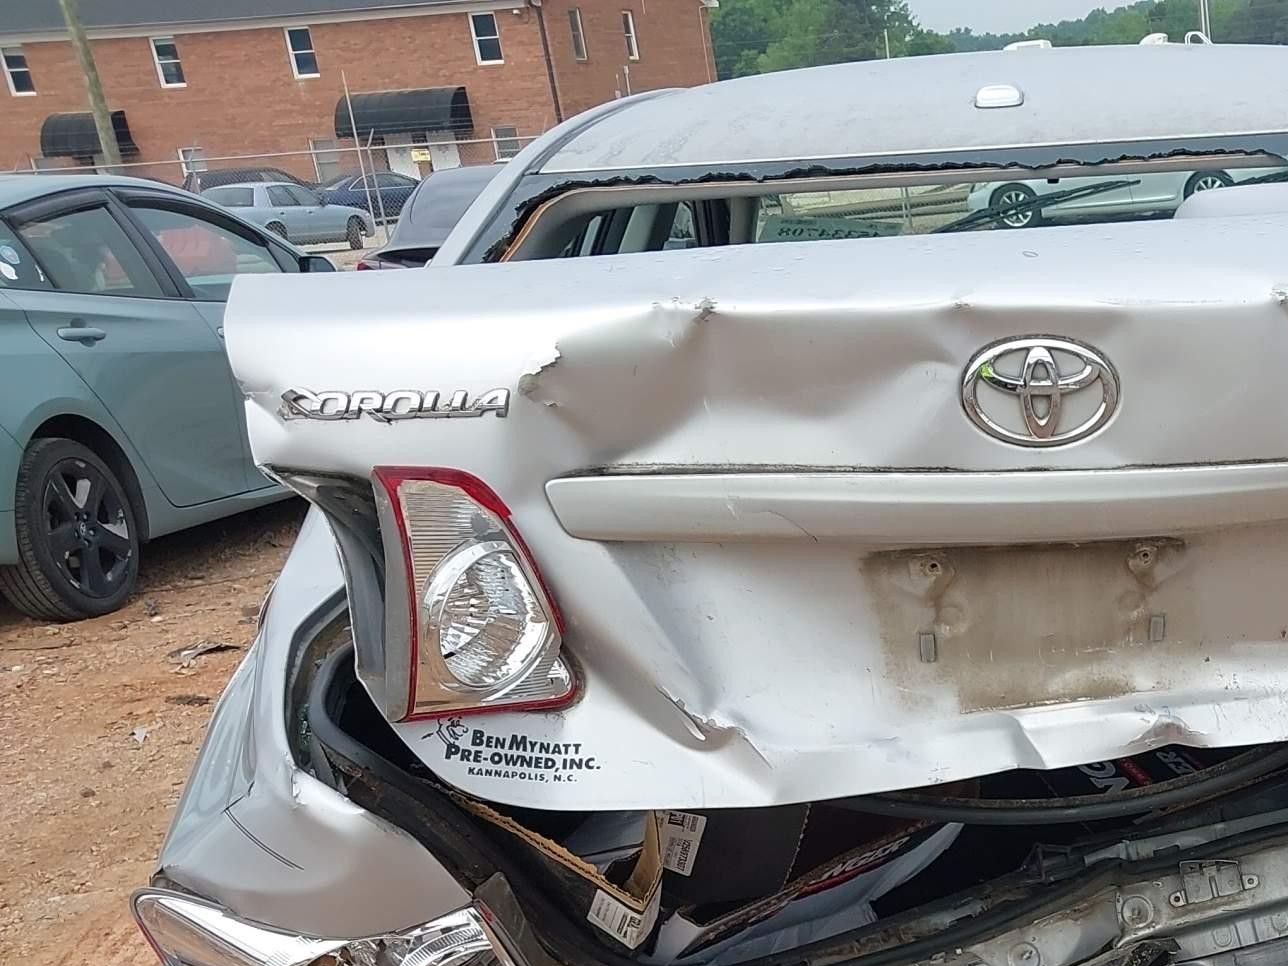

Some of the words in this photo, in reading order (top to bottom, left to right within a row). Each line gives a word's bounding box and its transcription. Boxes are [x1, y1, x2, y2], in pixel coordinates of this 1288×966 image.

[279, 386, 511, 425] COROLLA
[470, 729, 507, 750] BEN
[508, 734, 582, 756] MYNATT
[468, 767, 550, 783] KANNAPOLIS,
[553, 774, 578, 783] N.C.
